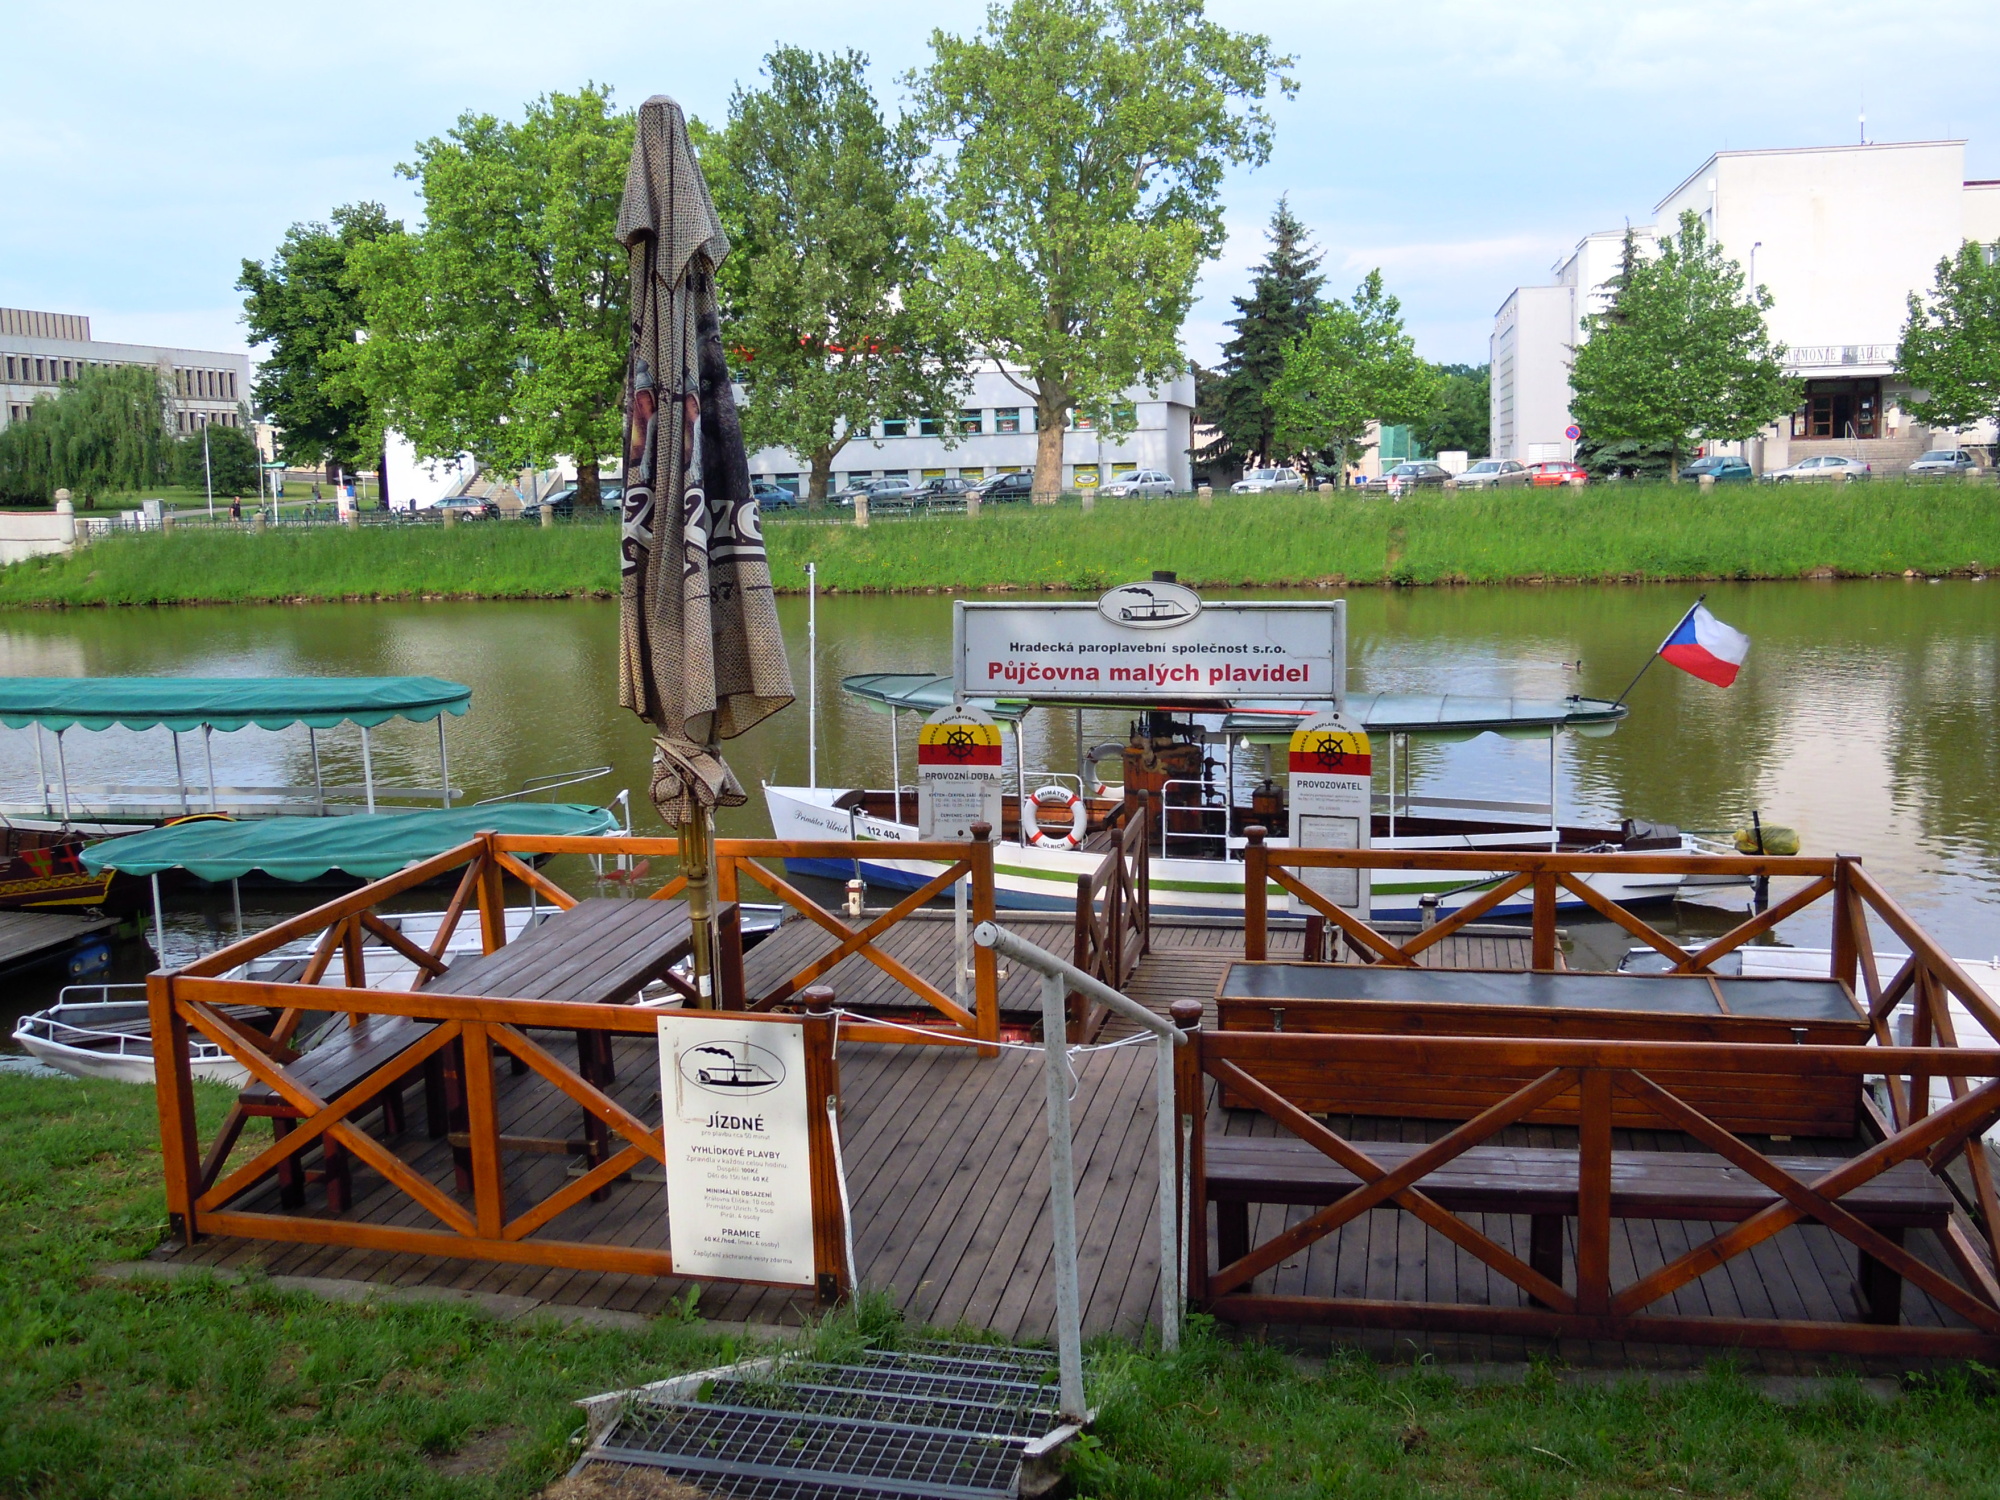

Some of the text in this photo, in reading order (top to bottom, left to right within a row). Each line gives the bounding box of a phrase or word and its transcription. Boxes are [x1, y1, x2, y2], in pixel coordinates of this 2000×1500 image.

[1009, 642, 1286, 656] Hradecká paroplavební společnost s.r.o.
[988, 661, 1309, 686] Půjčovna malých plavidel
[925, 771, 969, 780] PROVOZNÍ
[1297, 780, 1363, 791] PROVOZOVATEL
[1037, 790, 1069, 800] PRIMÁTOR
[826, 819, 849, 834] Ulrich
[867, 826, 901, 840] 112 404
[706, 1111, 764, 1132] JÍZDNÉ
[691, 1145, 780, 1159] VYHLÍDKOVÉ PLAVBY
[706, 1187, 772, 1198] MINIMÁLNÍ OBSAZENÍ
[722, 1228, 760, 1239] PRAMICE
